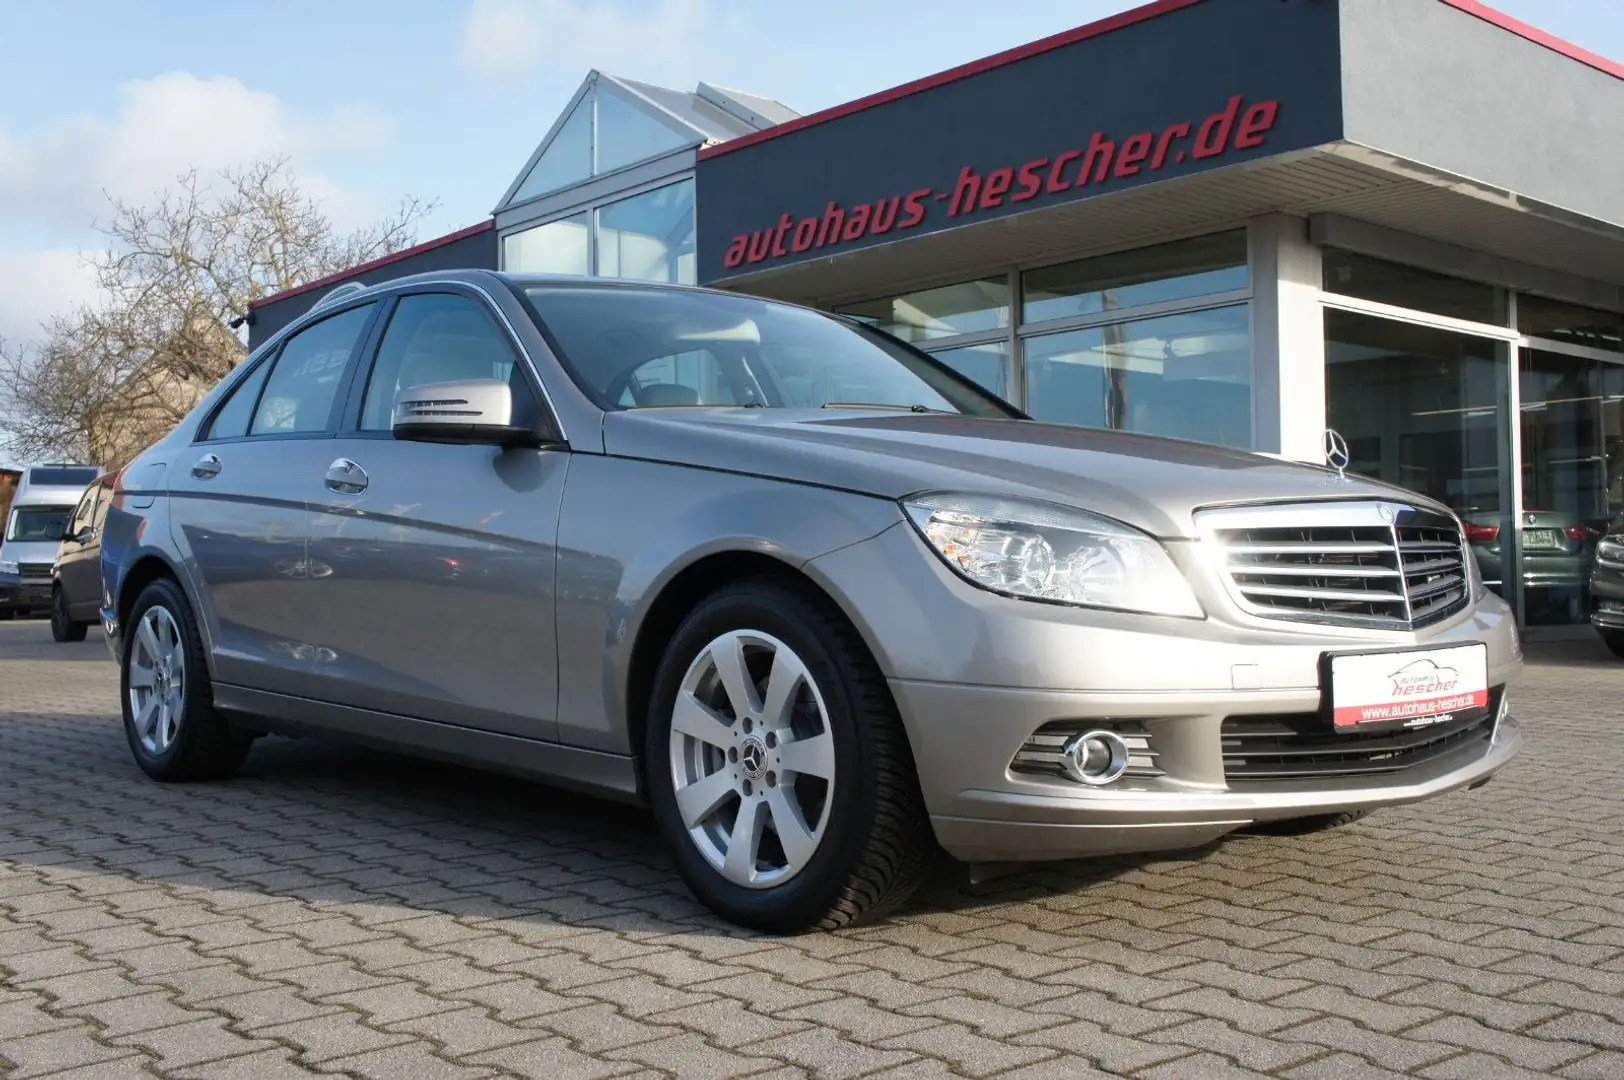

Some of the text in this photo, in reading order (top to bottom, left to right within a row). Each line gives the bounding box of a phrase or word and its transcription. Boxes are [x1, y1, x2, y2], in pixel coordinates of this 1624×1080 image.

[724, 95, 1278, 268] autohaus-hescher.de
[1391, 675, 1458, 696] hescher
[1361, 696, 1475, 719] www.autohaus-hescher.de
